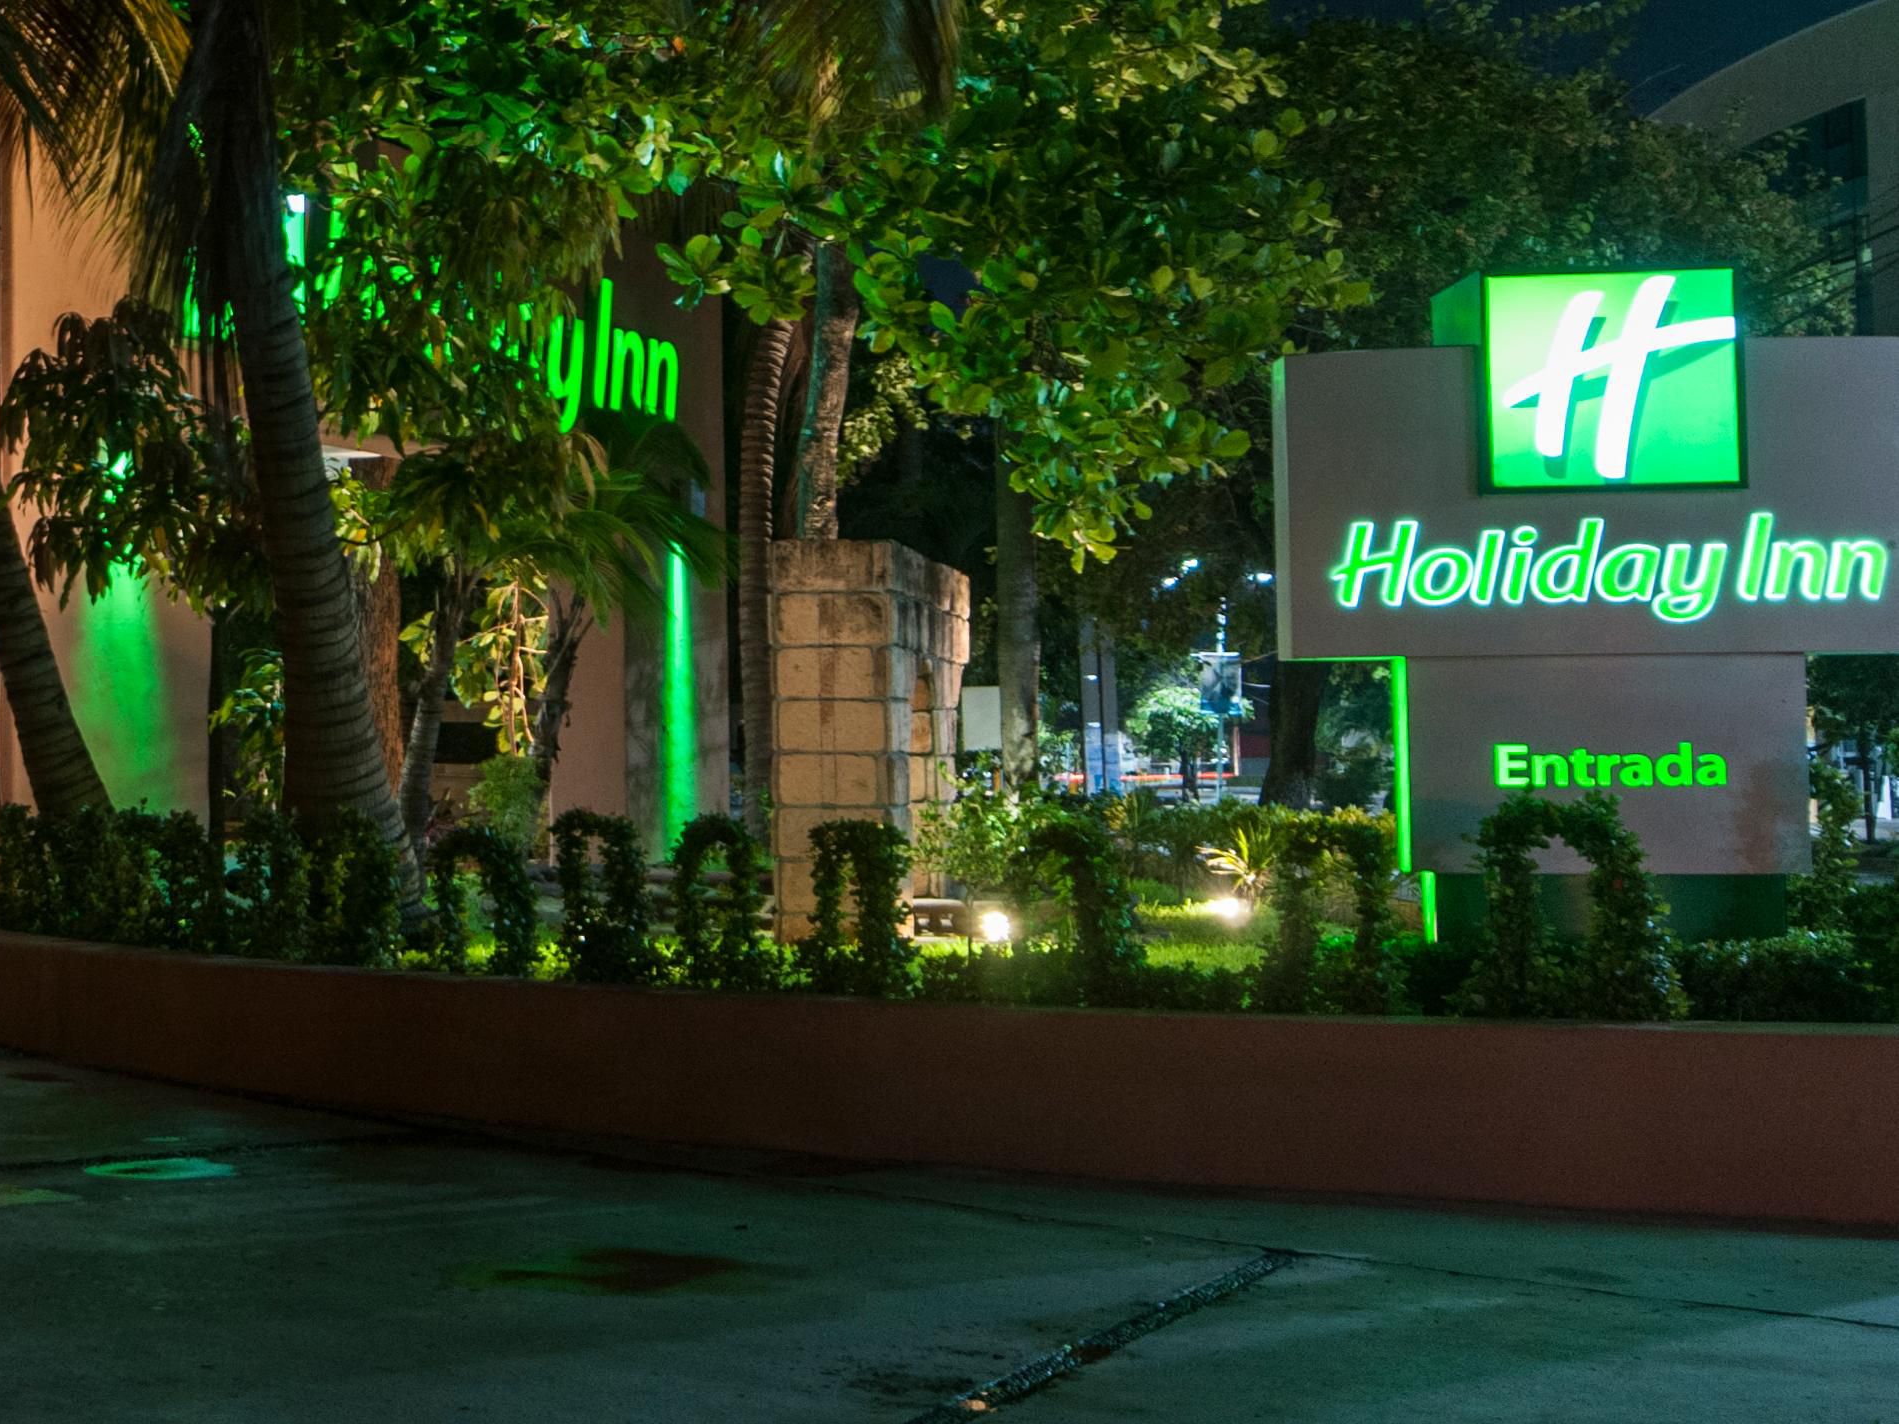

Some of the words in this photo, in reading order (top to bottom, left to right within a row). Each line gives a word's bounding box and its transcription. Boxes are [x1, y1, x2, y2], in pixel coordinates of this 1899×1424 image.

[592, 277, 680, 424] Inn
[1331, 517, 1728, 622] Holiday
[1736, 512, 1888, 602] Inn
[1494, 741, 1728, 788] Entrada
